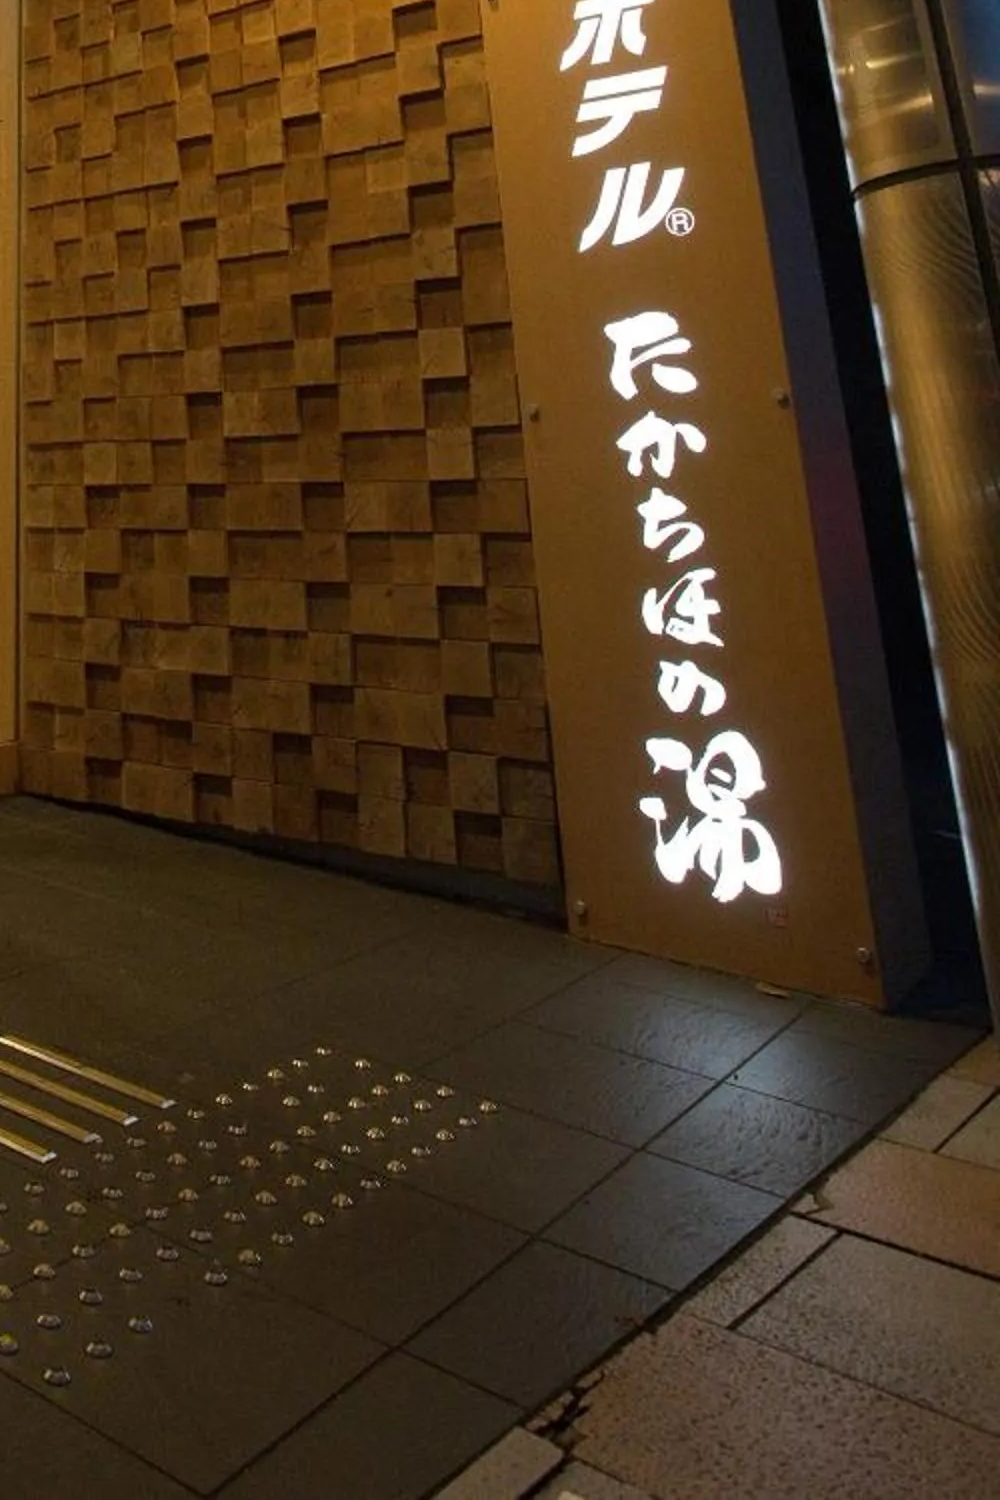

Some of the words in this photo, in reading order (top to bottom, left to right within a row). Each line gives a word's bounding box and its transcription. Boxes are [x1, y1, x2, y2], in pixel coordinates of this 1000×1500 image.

[603, 311, 782, 903] たかちほの湯
